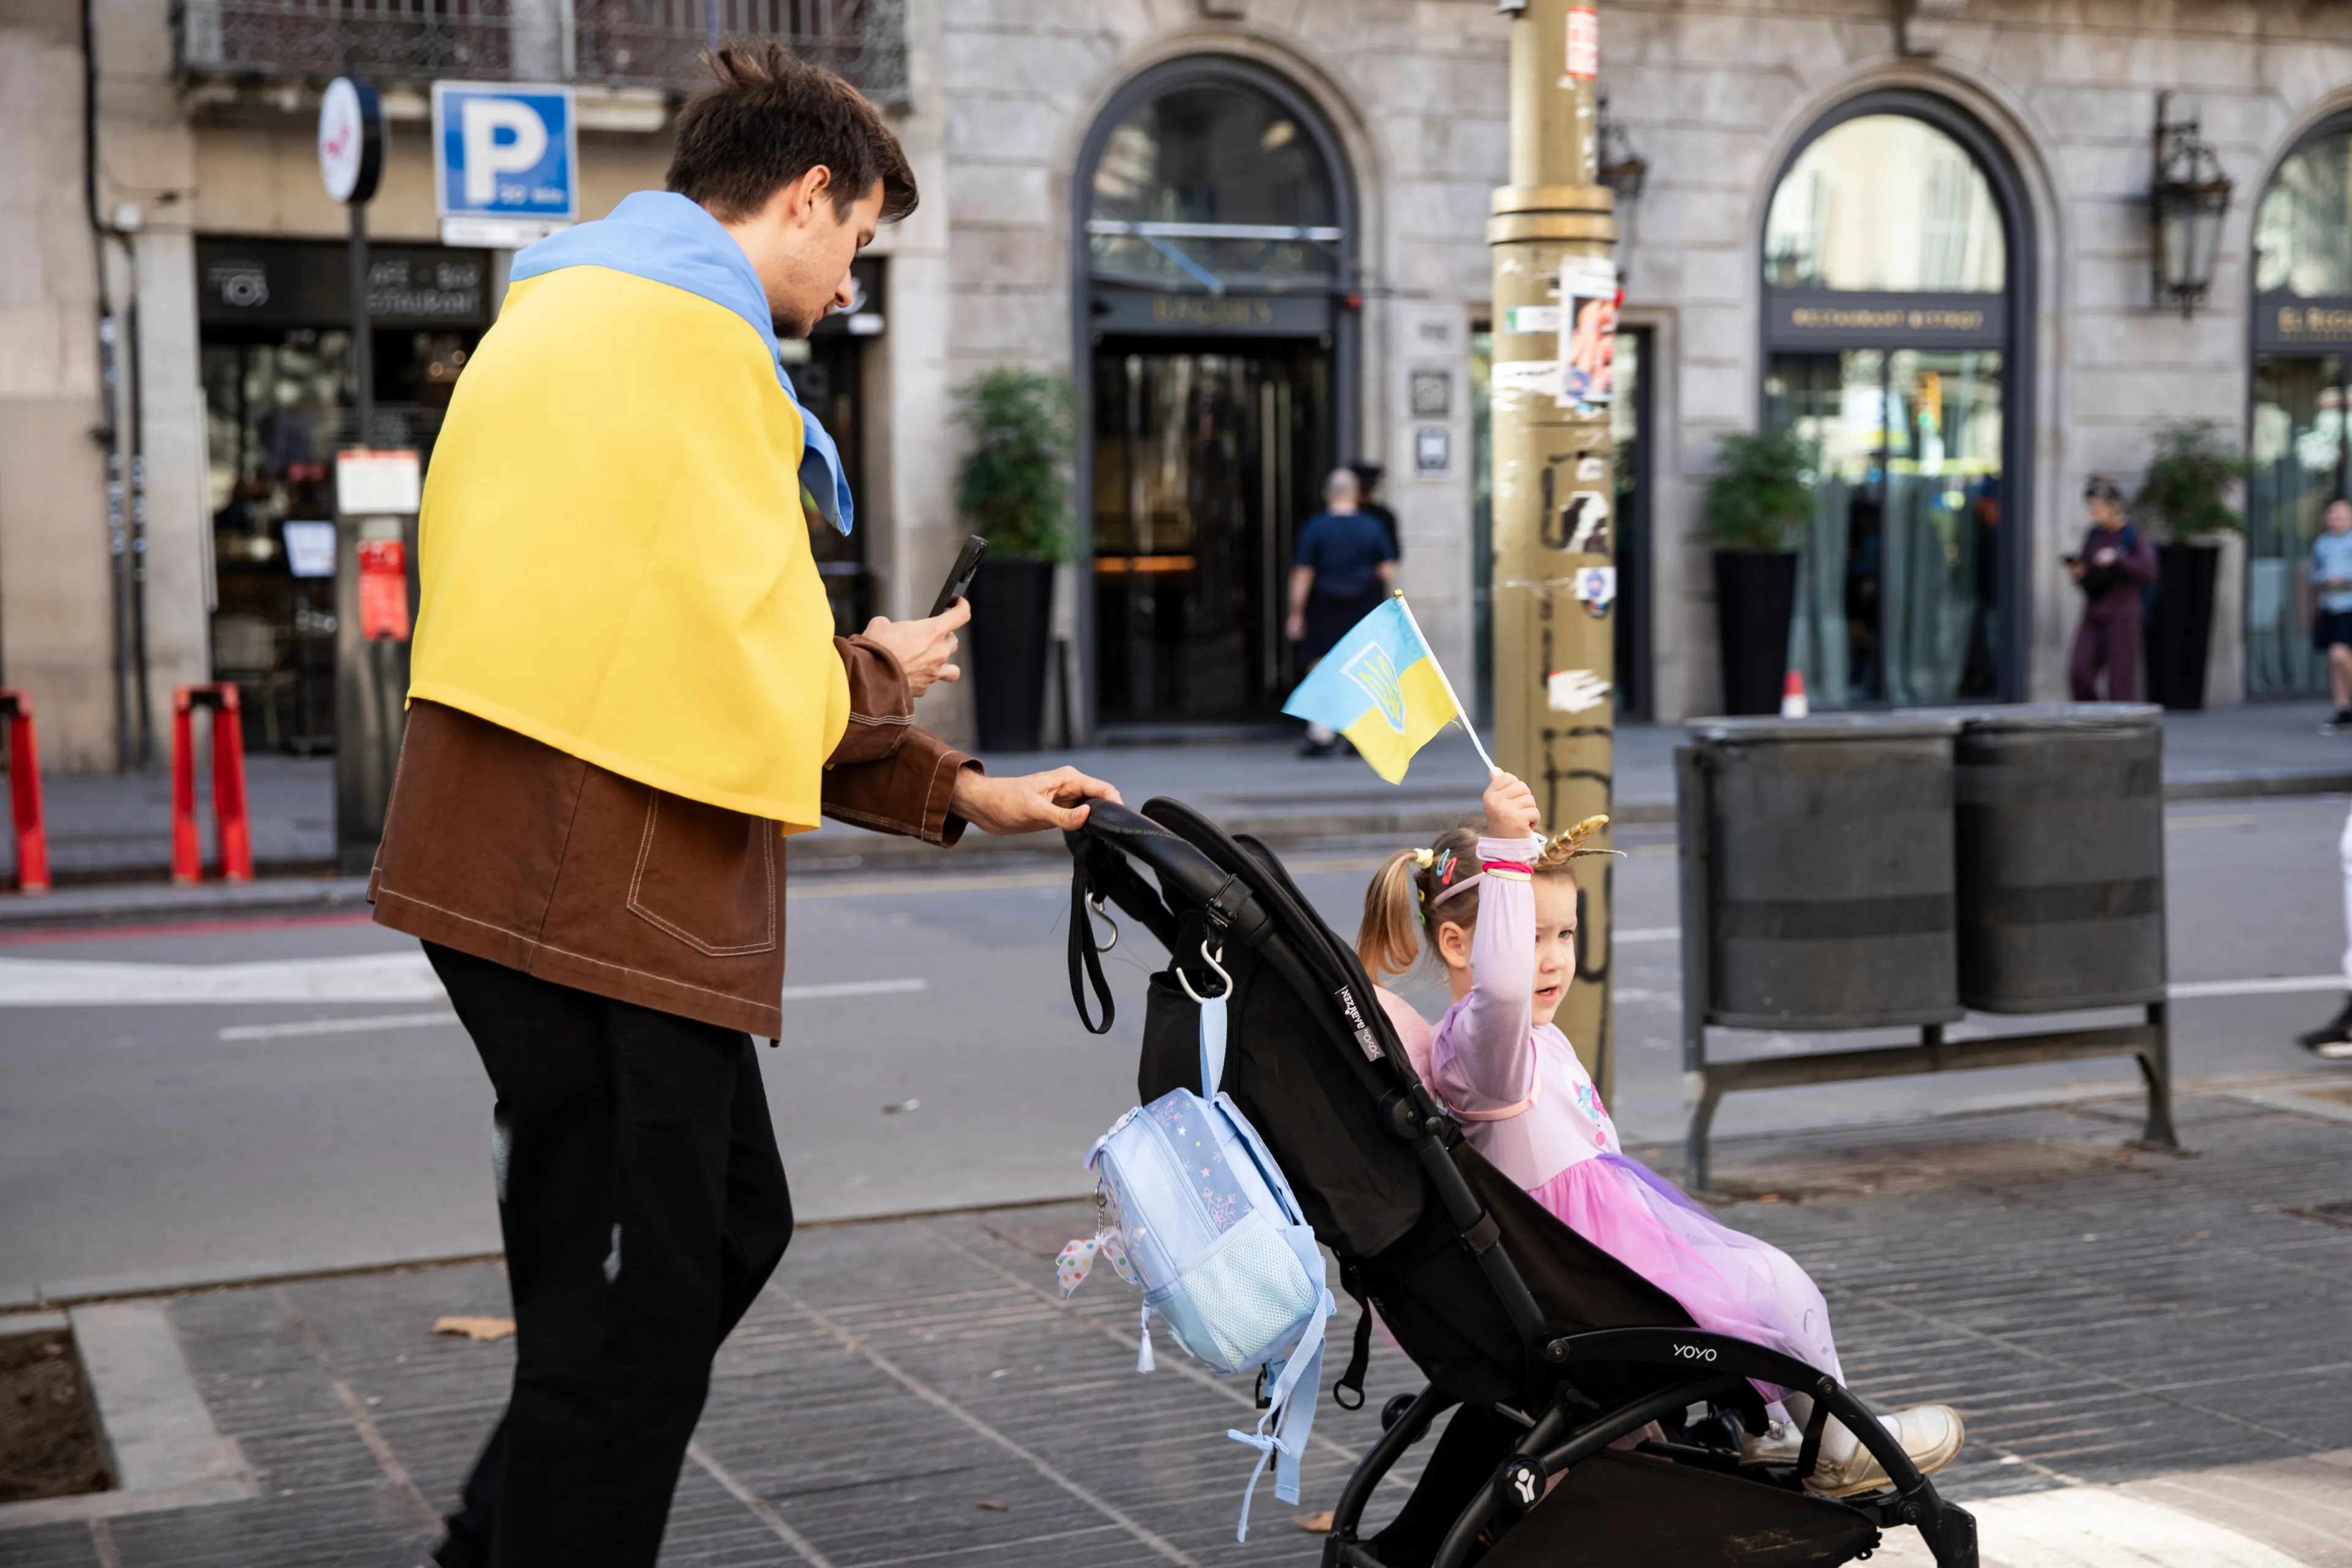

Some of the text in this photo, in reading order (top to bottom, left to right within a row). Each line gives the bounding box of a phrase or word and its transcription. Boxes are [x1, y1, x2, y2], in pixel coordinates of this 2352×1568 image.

[464, 99, 548, 205] P
[369, 262, 409, 287] AFE
[369, 288, 480, 315] ESTAURANT
[1341, 989, 1365, 1029] BABYZEN
[1363, 1034, 1380, 1057] YOYO
[1673, 1344, 1717, 1361] YOYO
